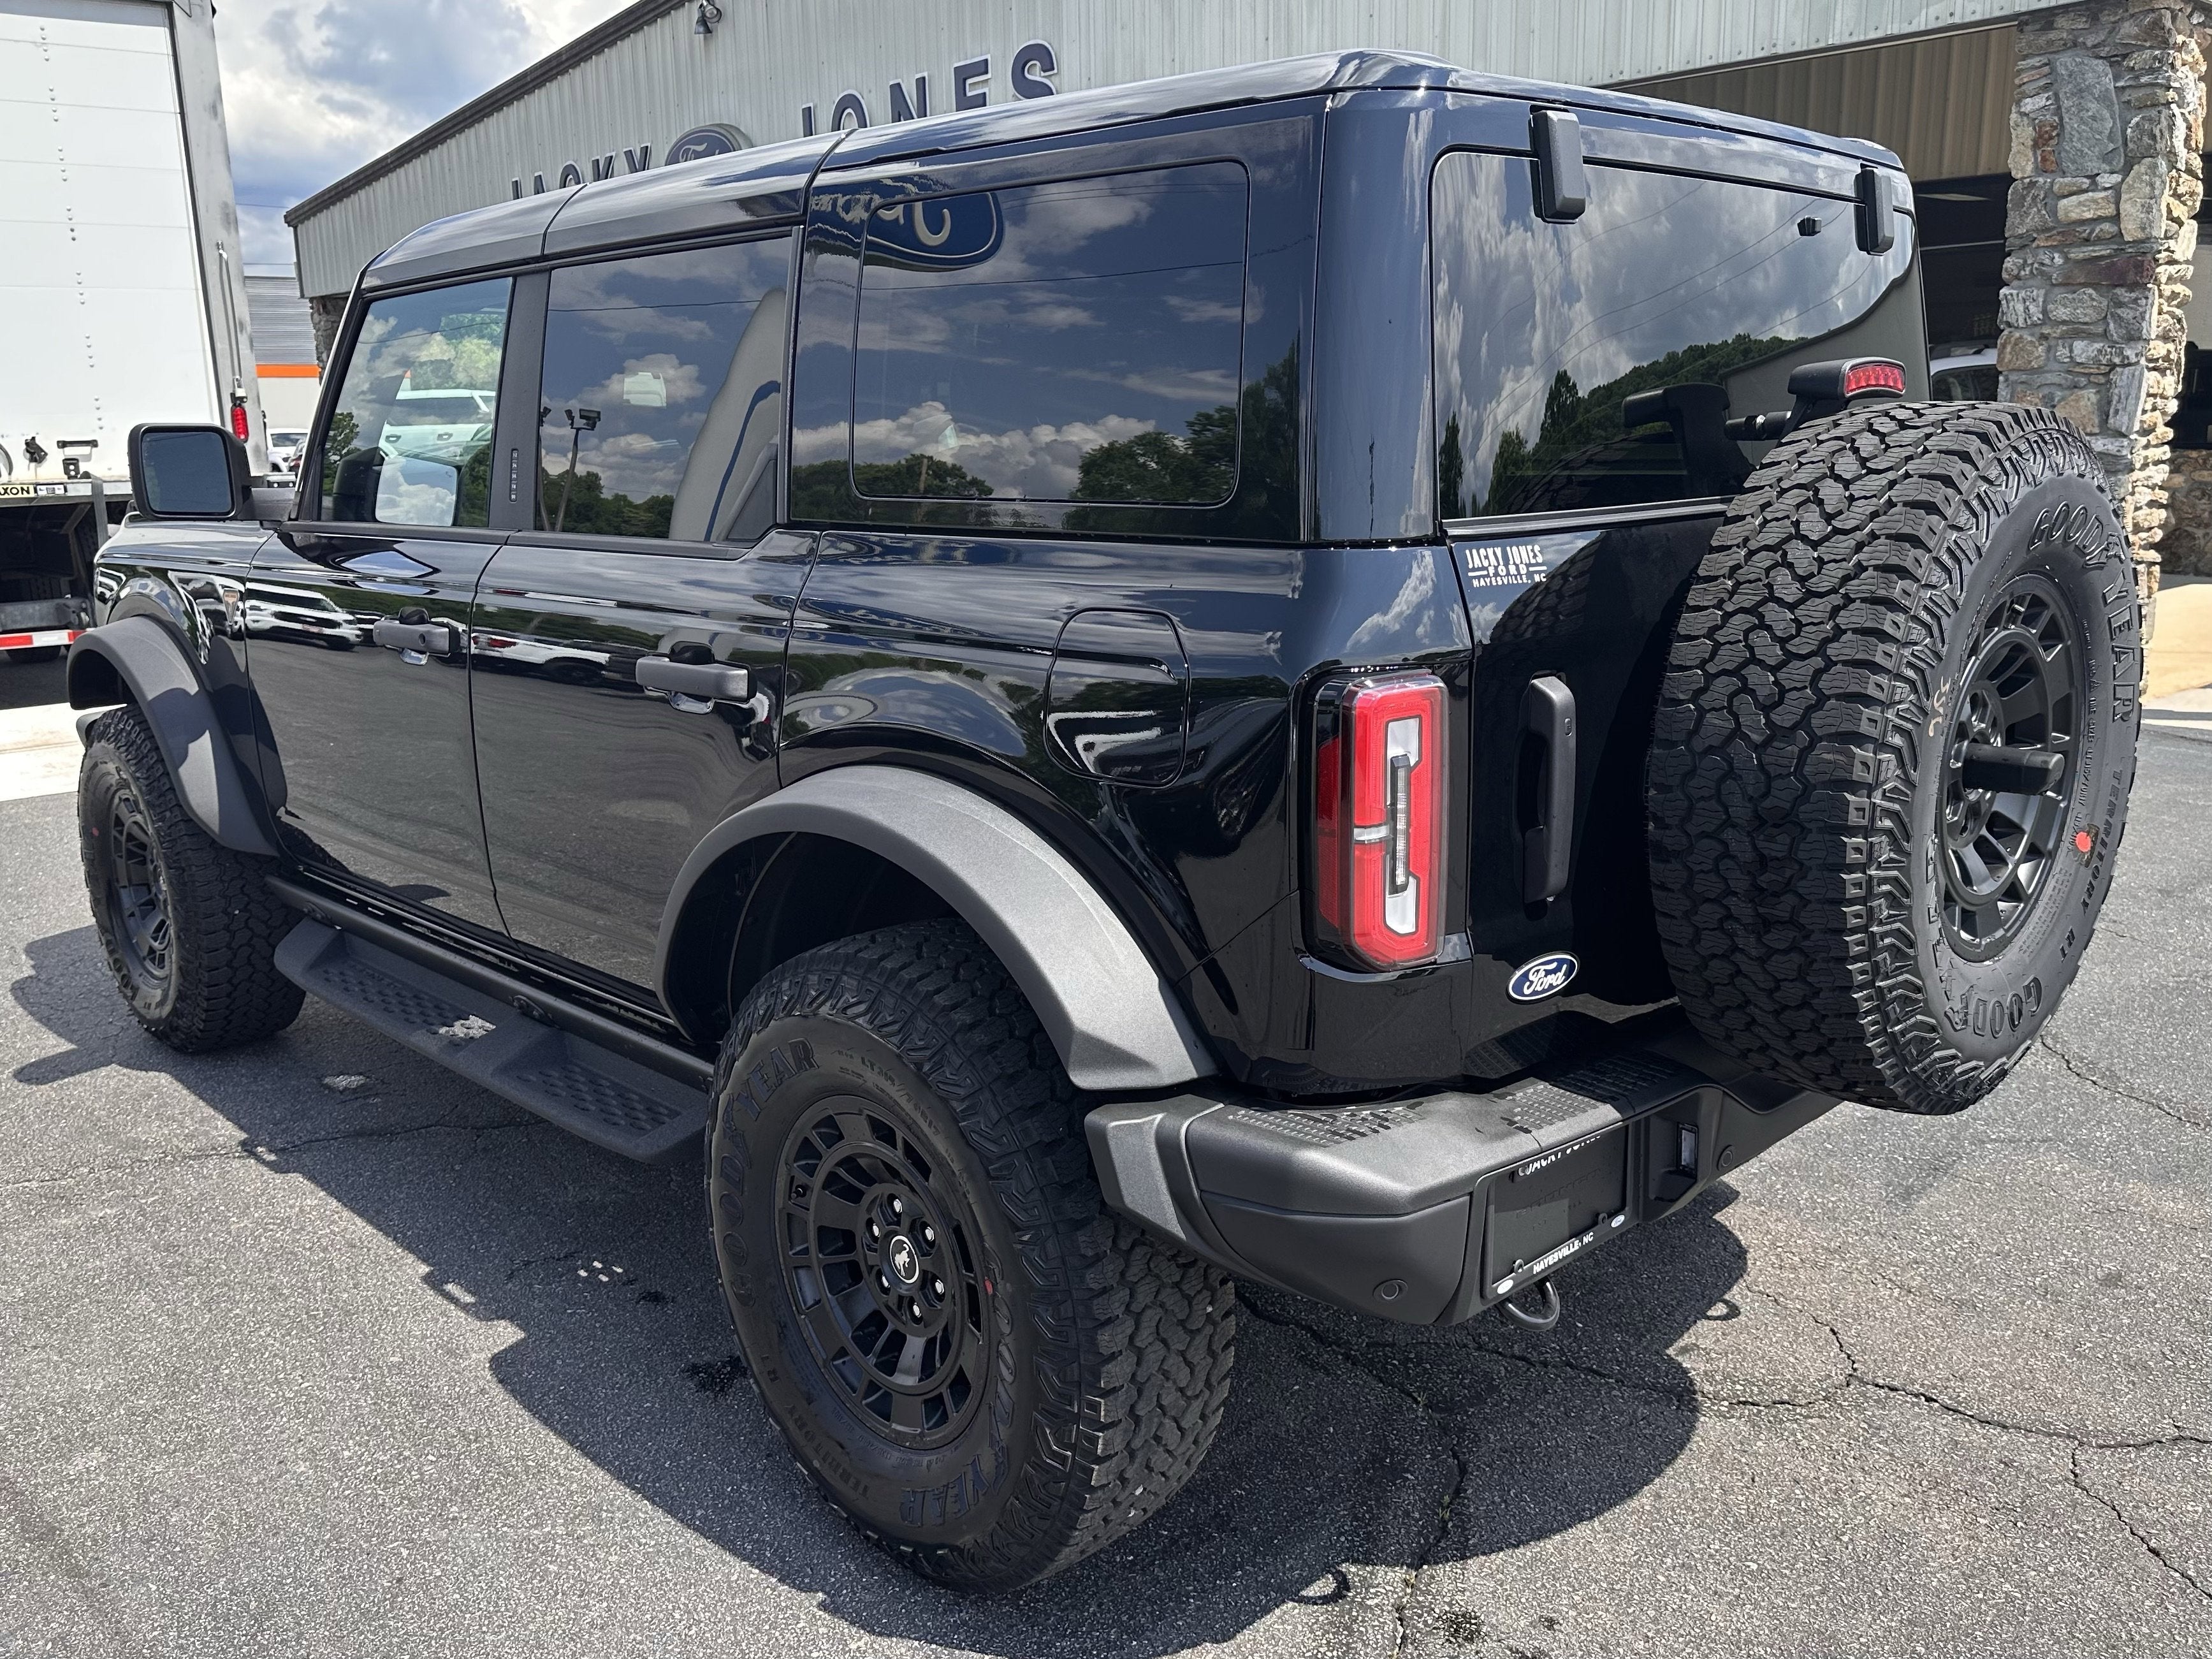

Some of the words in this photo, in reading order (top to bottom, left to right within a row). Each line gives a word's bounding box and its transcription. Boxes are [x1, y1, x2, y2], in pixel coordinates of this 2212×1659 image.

[0, 486, 30, 496] XON
[1466, 546, 1503, 569] JACKY
[1506, 544, 1543, 566] JONES
[1473, 574, 1531, 588] HAYESVILLE,
[1534, 573, 1547, 583] NC
[1488, 564, 1527, 577] FORD
[2080, 769, 2123, 916] TERRITORY
[1523, 961, 1568, 995] Ford
[1532, 1239, 1582, 1274] HAYESVILLE,
[1583, 1232, 1594, 1245] NC
